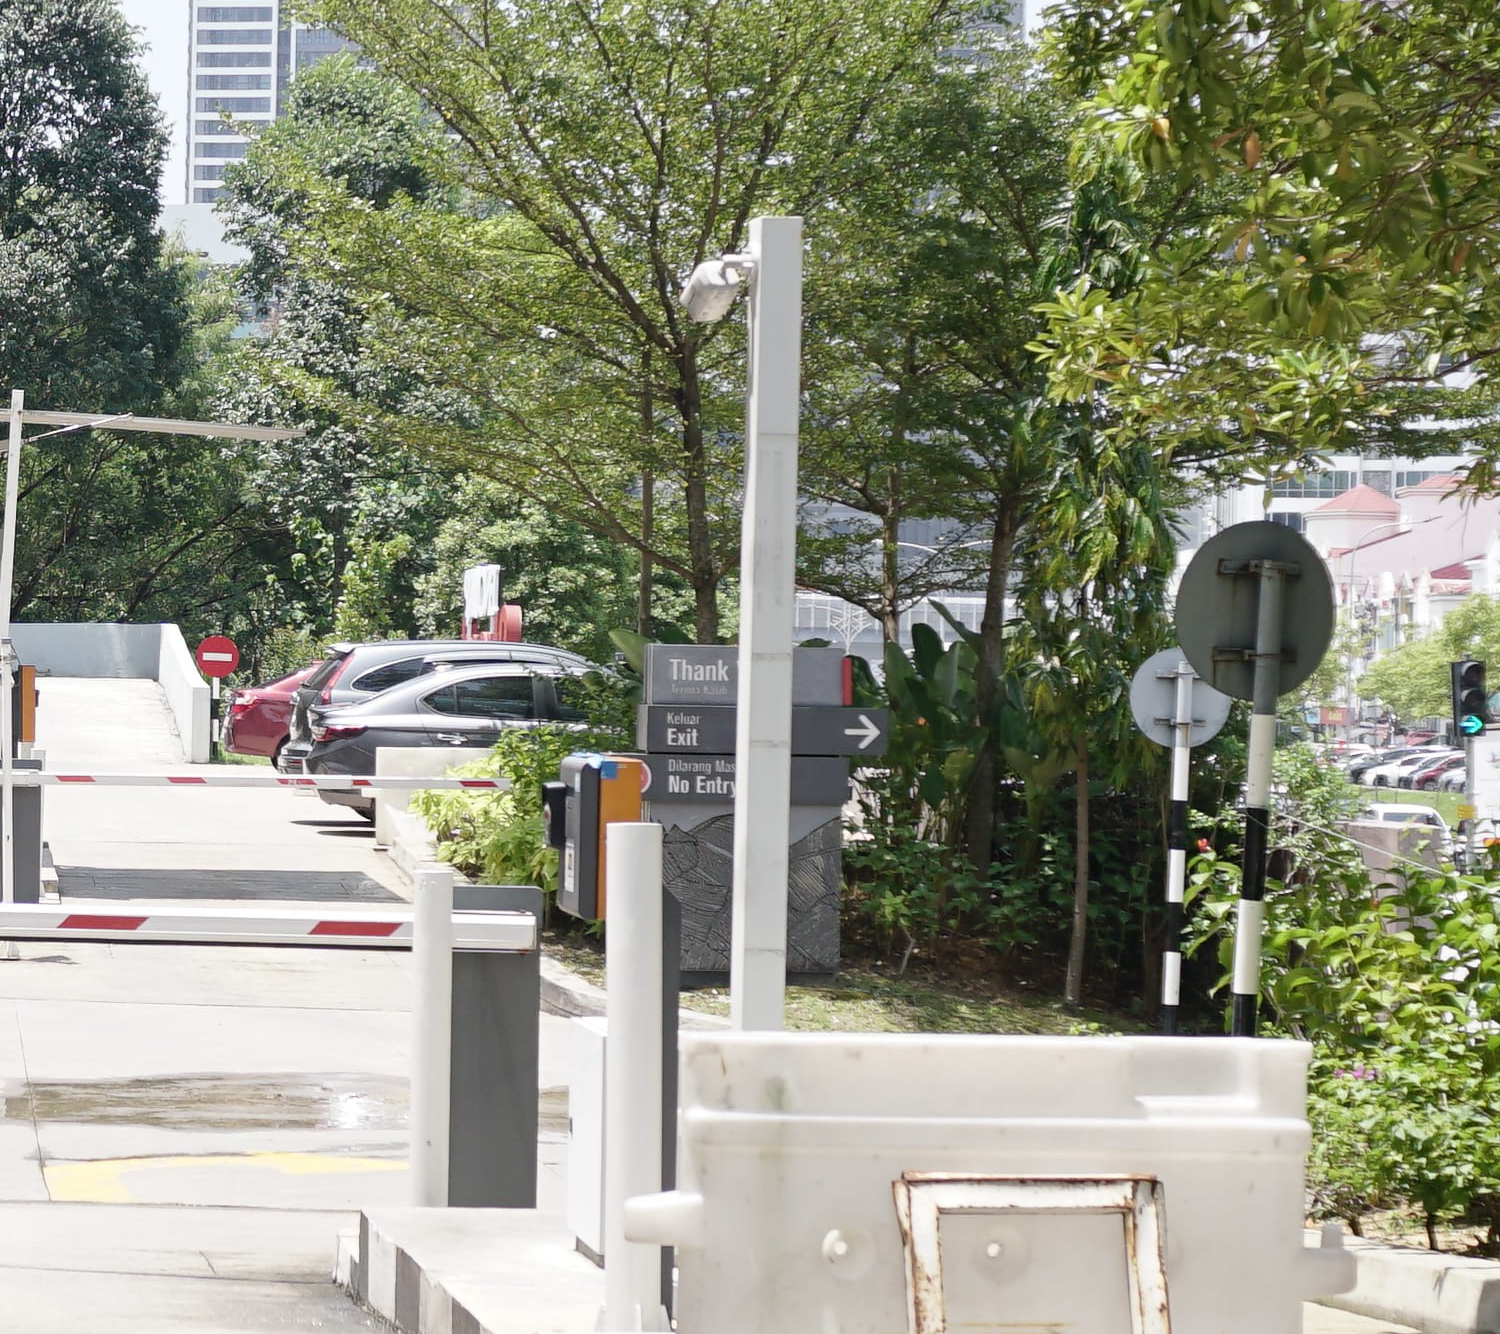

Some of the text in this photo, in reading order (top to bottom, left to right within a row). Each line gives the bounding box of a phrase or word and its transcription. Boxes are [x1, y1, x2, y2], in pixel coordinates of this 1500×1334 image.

[669, 658, 729, 682] Thank
[667, 712, 701, 725] Keluar
[667, 728, 700, 747] Exit
[668, 759, 737, 775] Dilarang Mas
[668, 776, 737, 798] No Entry
